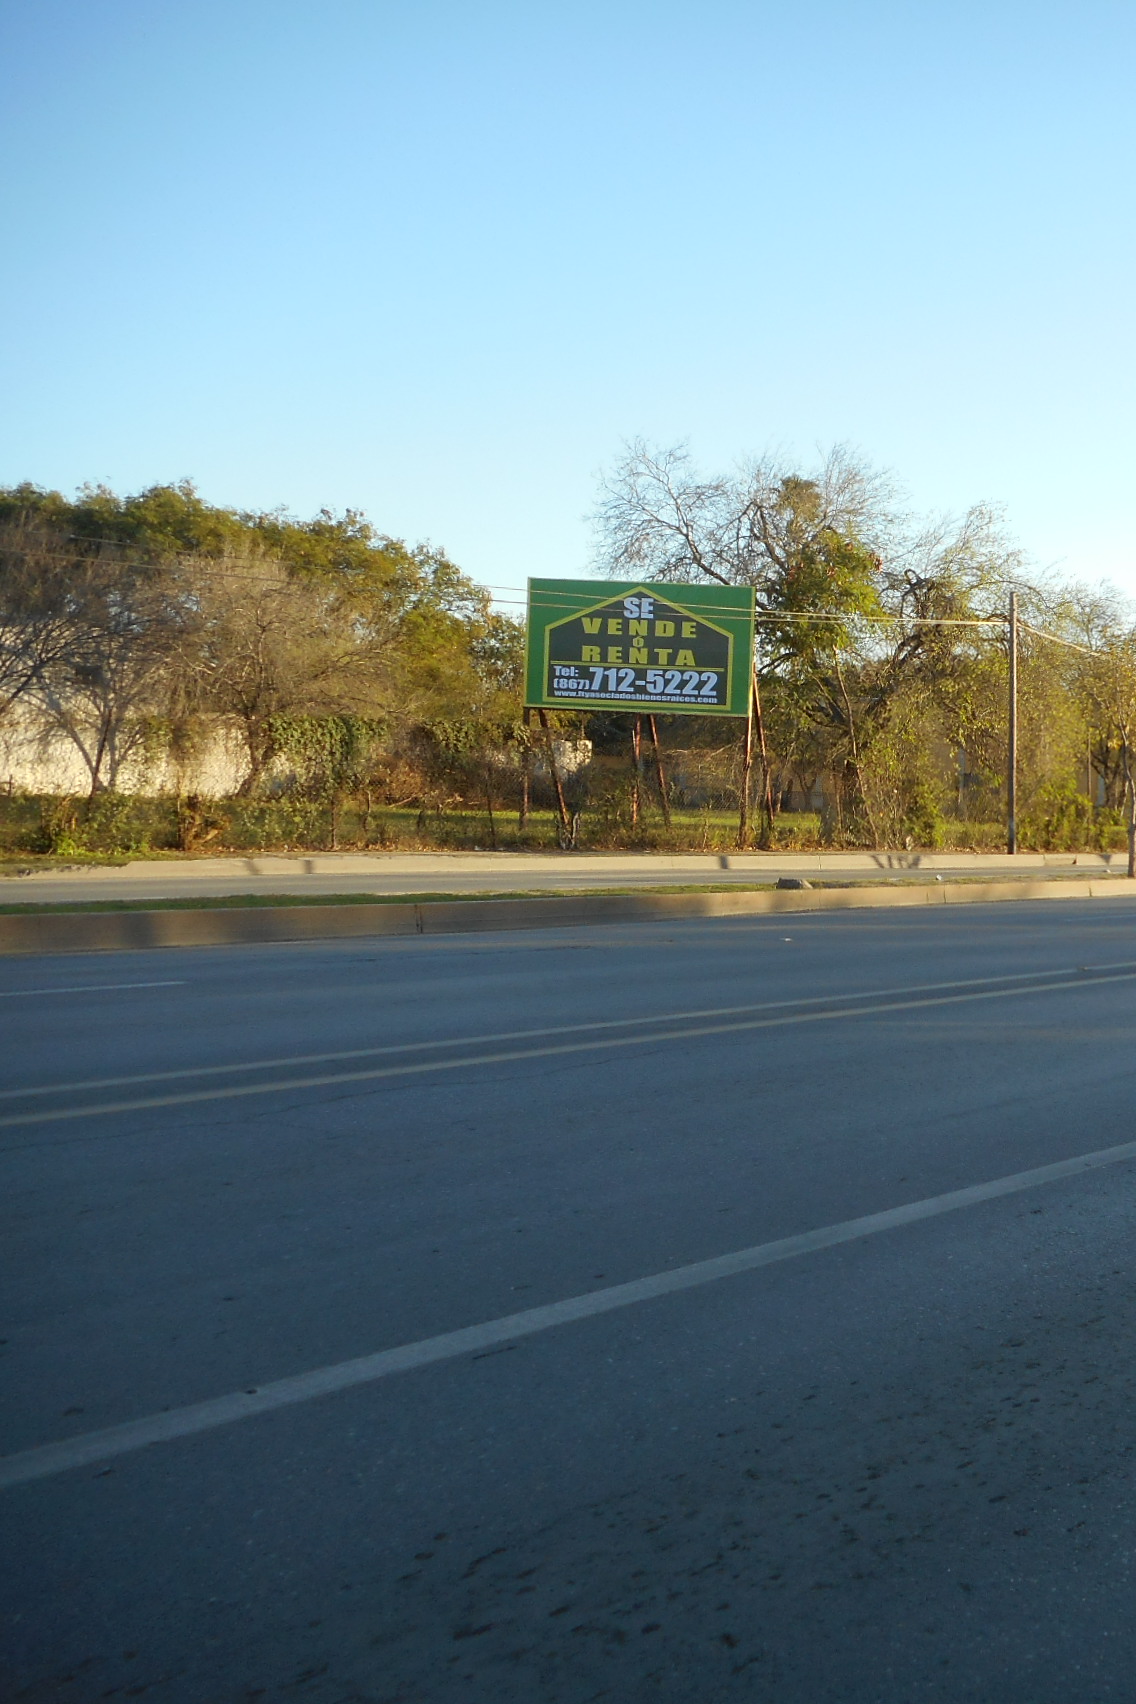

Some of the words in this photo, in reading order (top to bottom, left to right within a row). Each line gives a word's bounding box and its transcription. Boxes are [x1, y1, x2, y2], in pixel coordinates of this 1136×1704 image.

[623, 597, 654, 619] SE
[581, 617, 697, 638] VENDE
[581, 645, 696, 666] RENTA
[553, 665, 580, 677] Tel:
[553, 678, 590, 690] (867)
[589, 666, 718, 696] 712-5222
